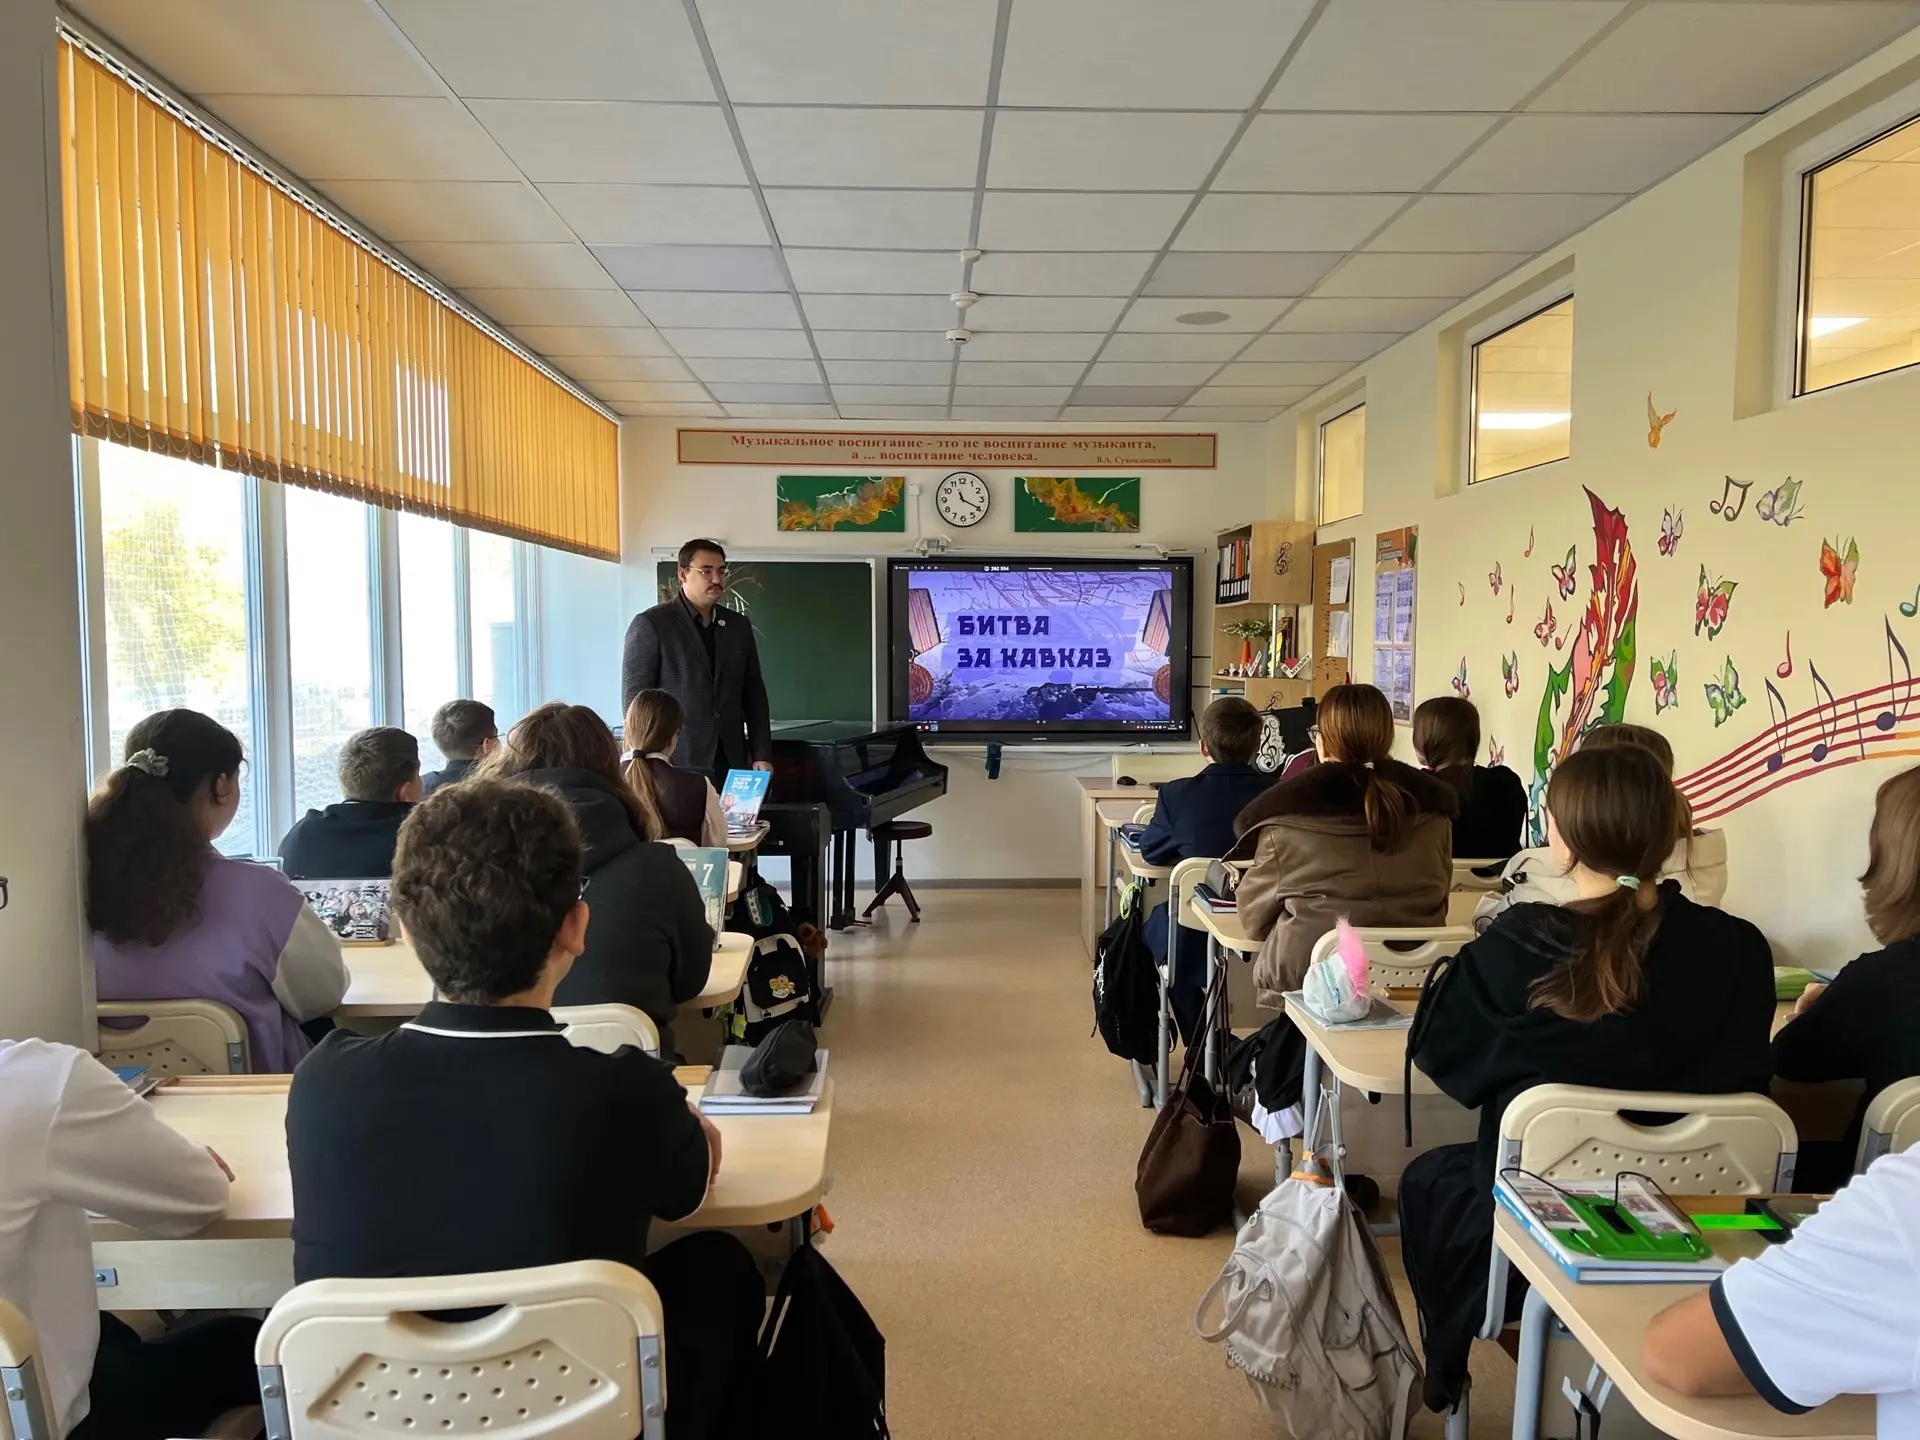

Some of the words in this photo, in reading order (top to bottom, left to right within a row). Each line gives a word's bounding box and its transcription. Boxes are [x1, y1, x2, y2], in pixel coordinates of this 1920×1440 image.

[731, 435, 834, 448] Музыкальное
[838, 439, 923, 447] воспитание
[937, 440, 959, 448] это
[963, 440, 980, 448] не
[984, 440, 1067, 449] воспитание
[1072, 441, 1156, 451] музыканта,
[851, 451, 859, 459] а
[880, 452, 964, 460] воспитание
[968, 453, 1038, 461] человека.
[957, 615, 1050, 636] БИТВА
[957, 648, 992, 668] ЗА
[1000, 648, 1112, 668] КАВКАЗ
[753, 777, 762, 790] 7
[703, 863, 714, 886] 7
